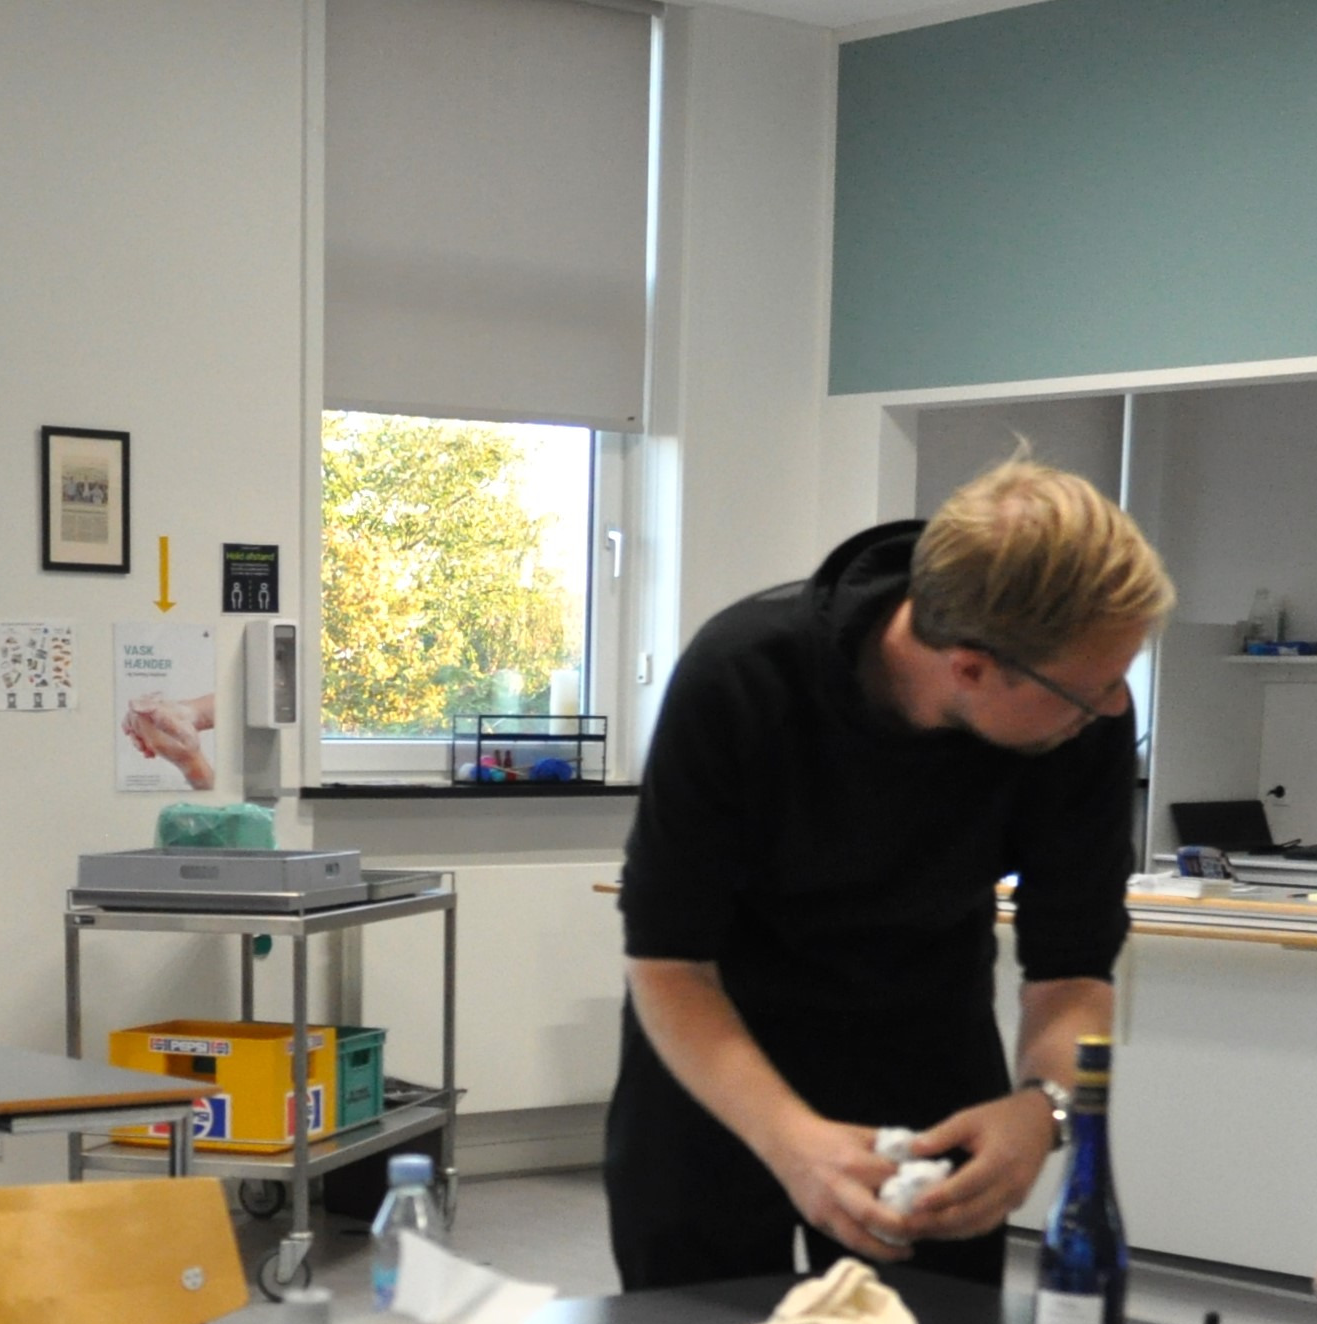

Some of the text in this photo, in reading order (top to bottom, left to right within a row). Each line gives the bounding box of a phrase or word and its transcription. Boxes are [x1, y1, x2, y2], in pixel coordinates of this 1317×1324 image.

[124, 645, 154, 656] VASK
[124, 659, 173, 670] HÆNDER
[171, 1040, 208, 1053] PEPSI
